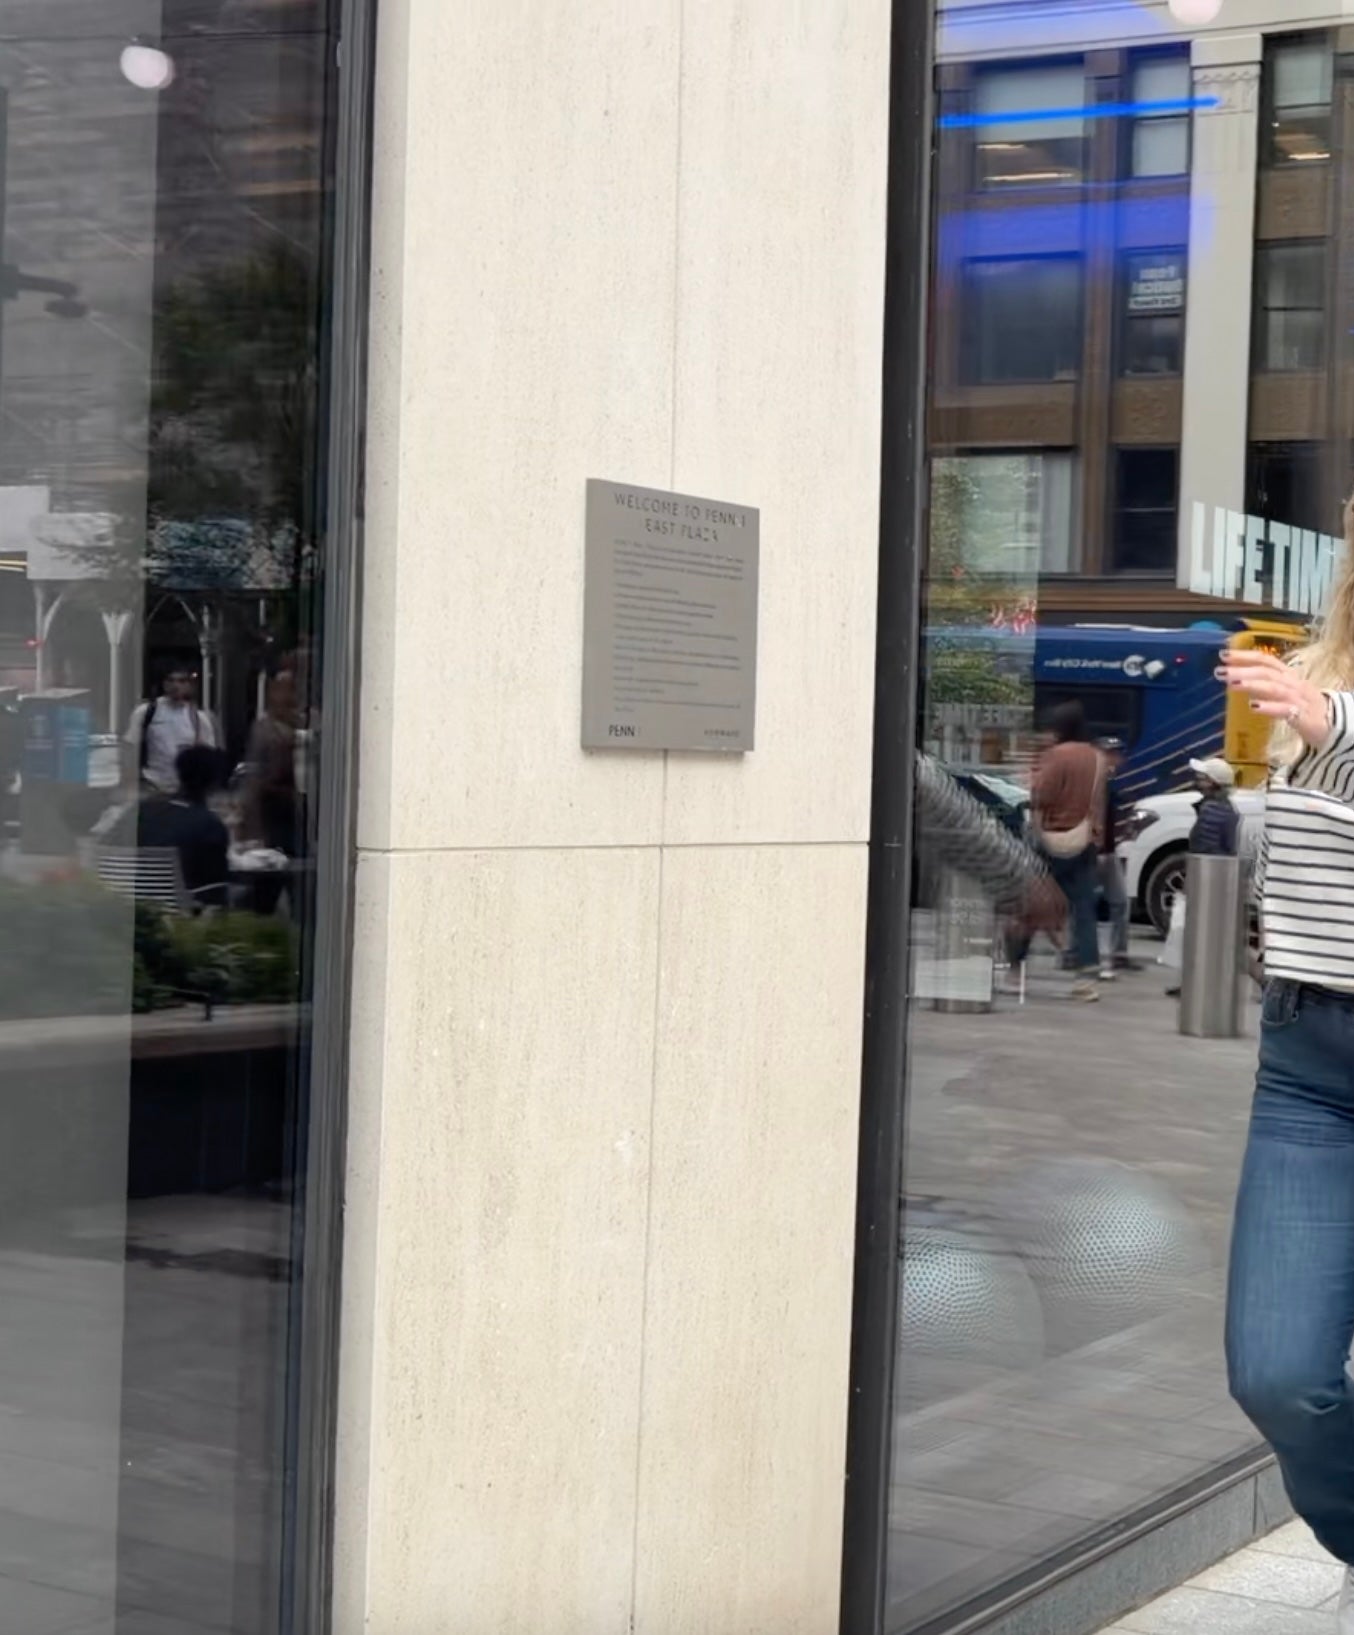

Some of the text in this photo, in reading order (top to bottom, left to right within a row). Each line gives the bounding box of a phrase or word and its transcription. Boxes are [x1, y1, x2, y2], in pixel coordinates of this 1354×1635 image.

[614, 491, 680, 517] WELCOME
[684, 504, 701, 521] TO
[705, 508, 737, 527] PENN
[644, 518, 677, 536] EAST
[608, 724, 635, 737] PENN
